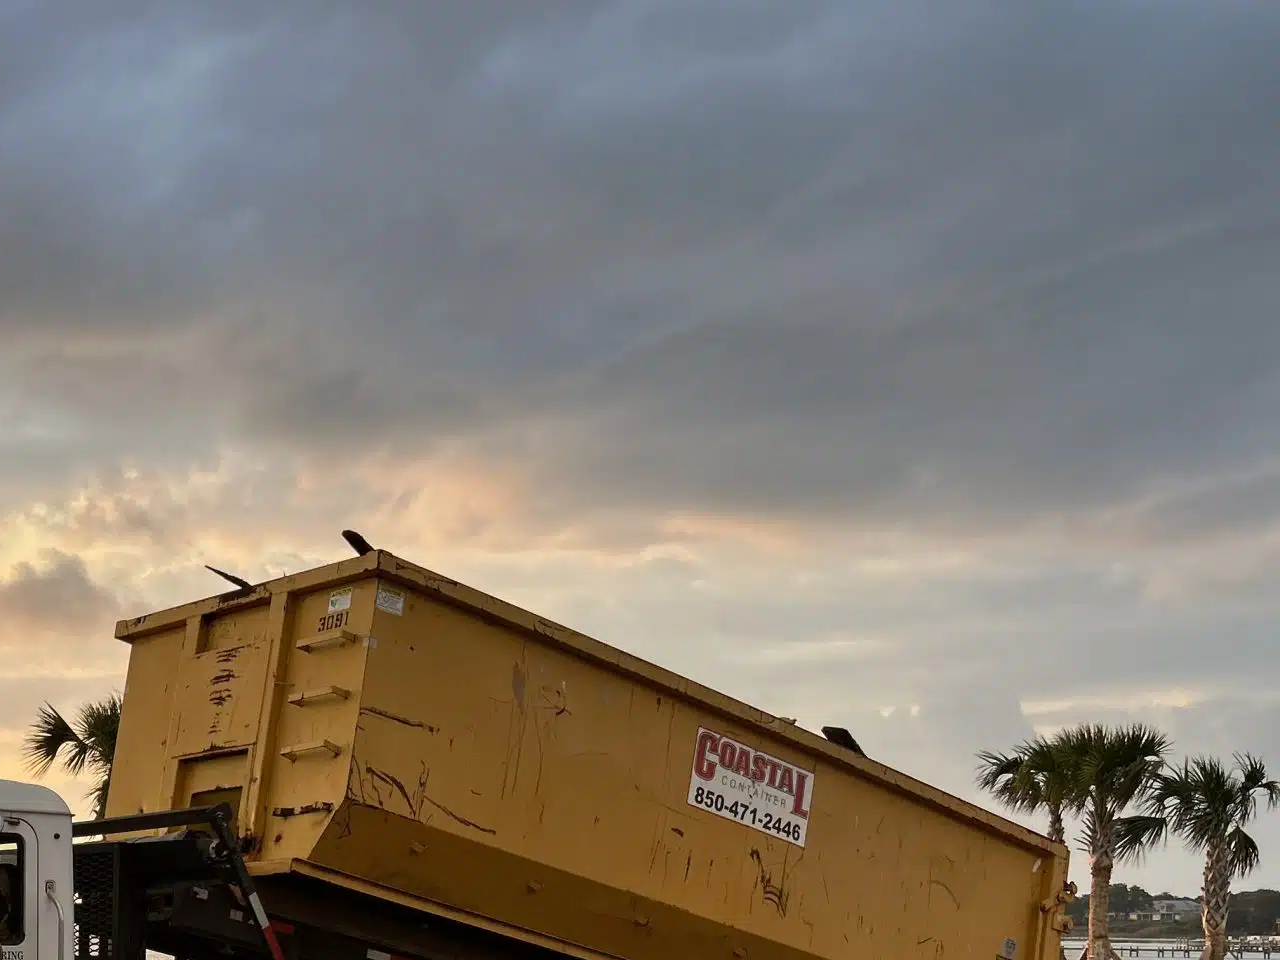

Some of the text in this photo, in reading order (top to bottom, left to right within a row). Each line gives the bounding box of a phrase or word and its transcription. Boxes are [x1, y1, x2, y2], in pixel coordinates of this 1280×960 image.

[694, 731, 809, 820] COASTAL
[721, 775, 787, 808] CONTAINER
[694, 787, 801, 841] 850-471-2446
